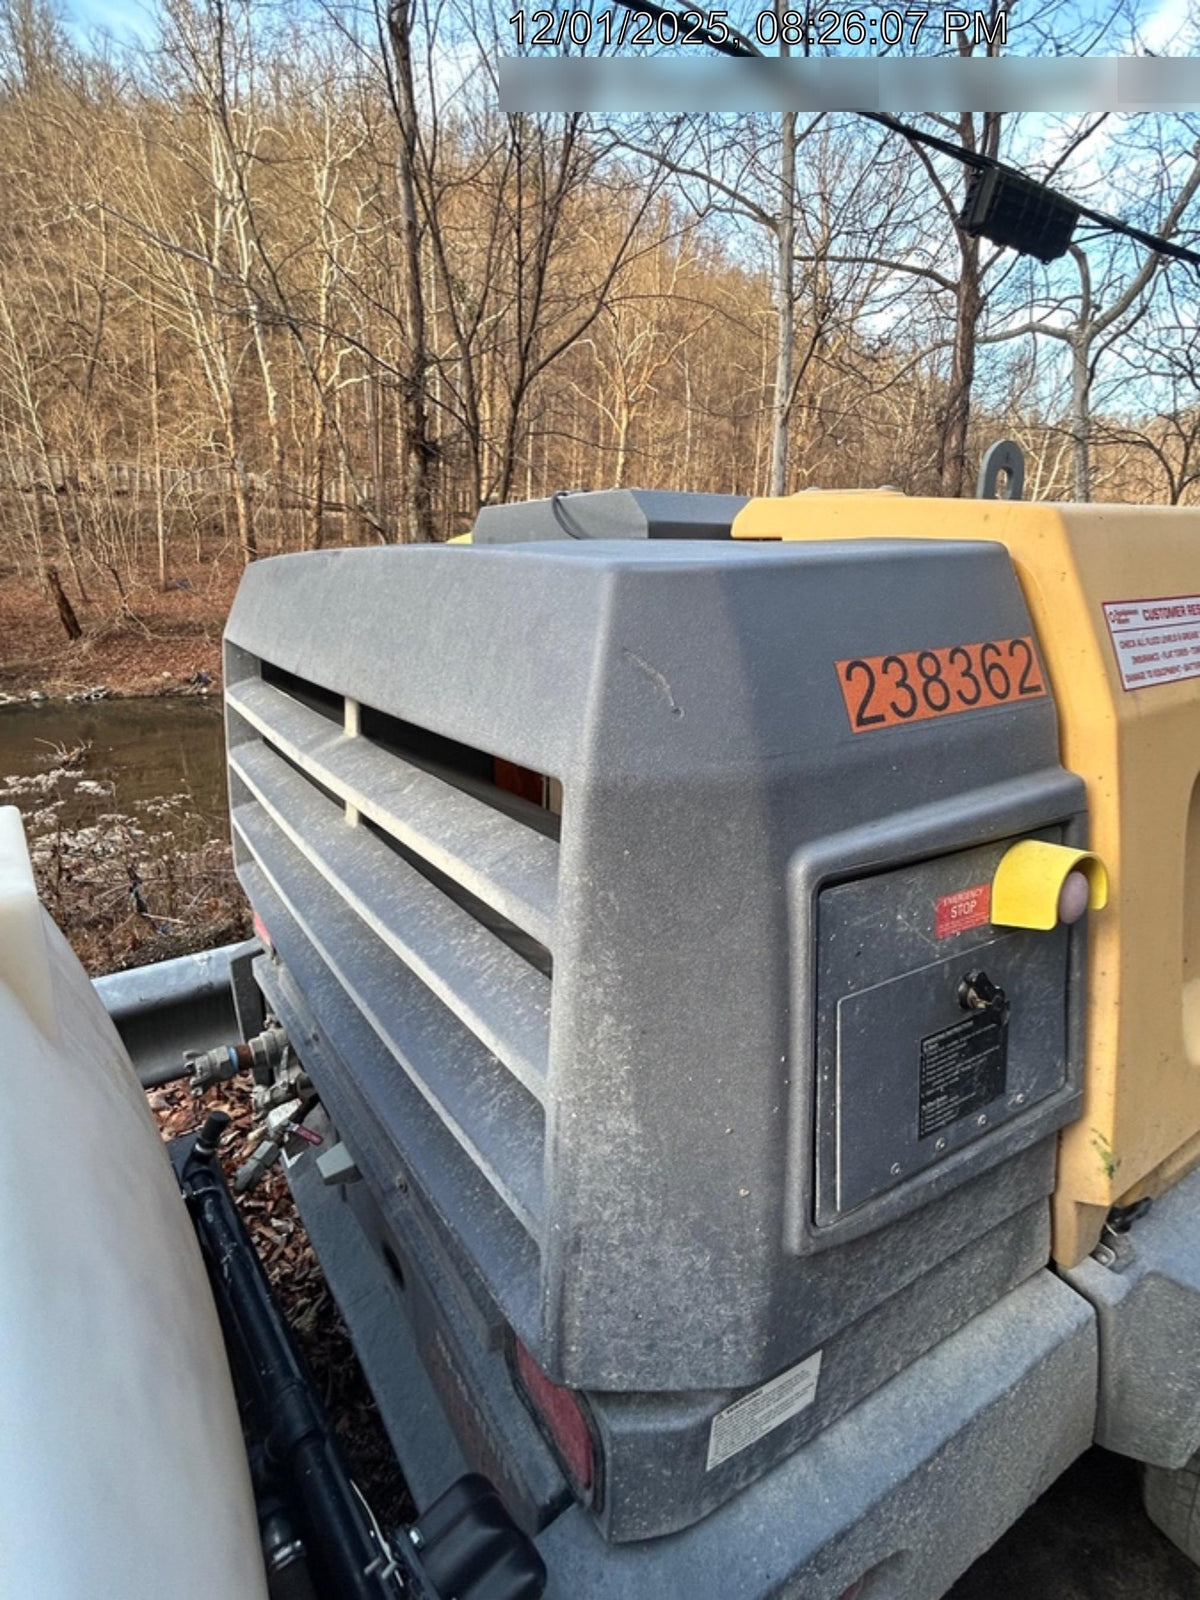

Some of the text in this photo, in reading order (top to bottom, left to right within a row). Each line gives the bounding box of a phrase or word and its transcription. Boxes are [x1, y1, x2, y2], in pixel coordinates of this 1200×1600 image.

[1142, 606, 1185, 621] CUSTOMER
[846, 639, 1042, 727] 238362
[951, 899, 977, 918] STOP
